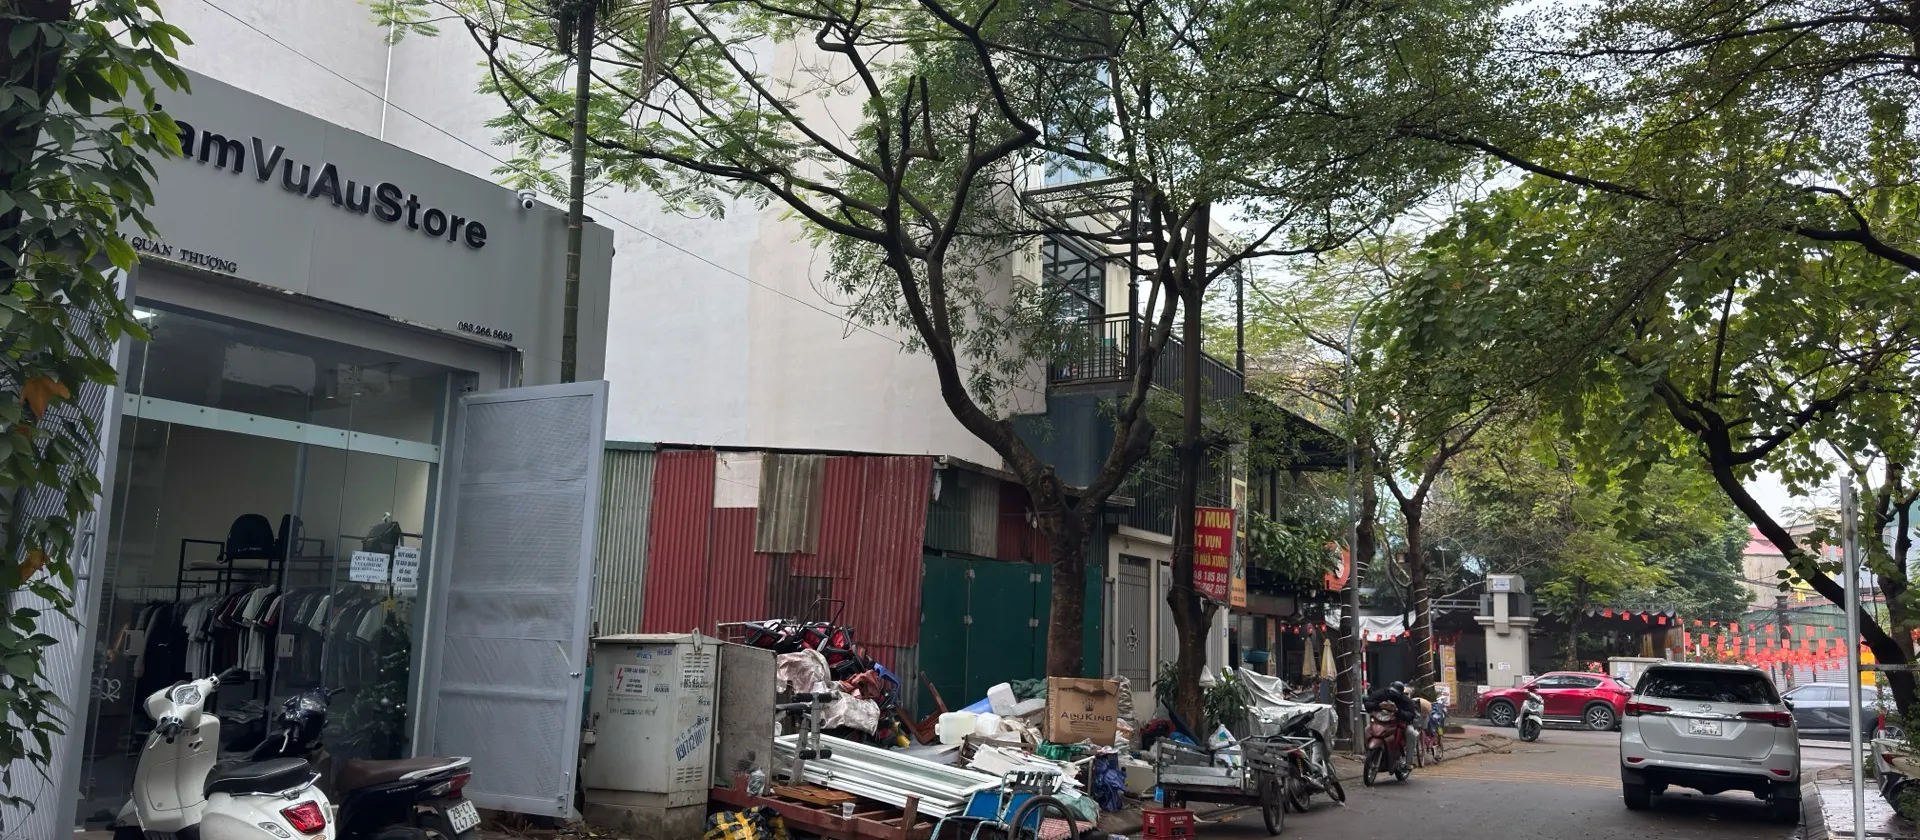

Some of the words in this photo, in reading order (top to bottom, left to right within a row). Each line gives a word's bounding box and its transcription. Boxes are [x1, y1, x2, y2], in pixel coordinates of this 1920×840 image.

[147, 103, 488, 250] amVuAuStore
[179, 248, 237, 273] THƯỢNG
[1204, 511, 1231, 529] MUA
